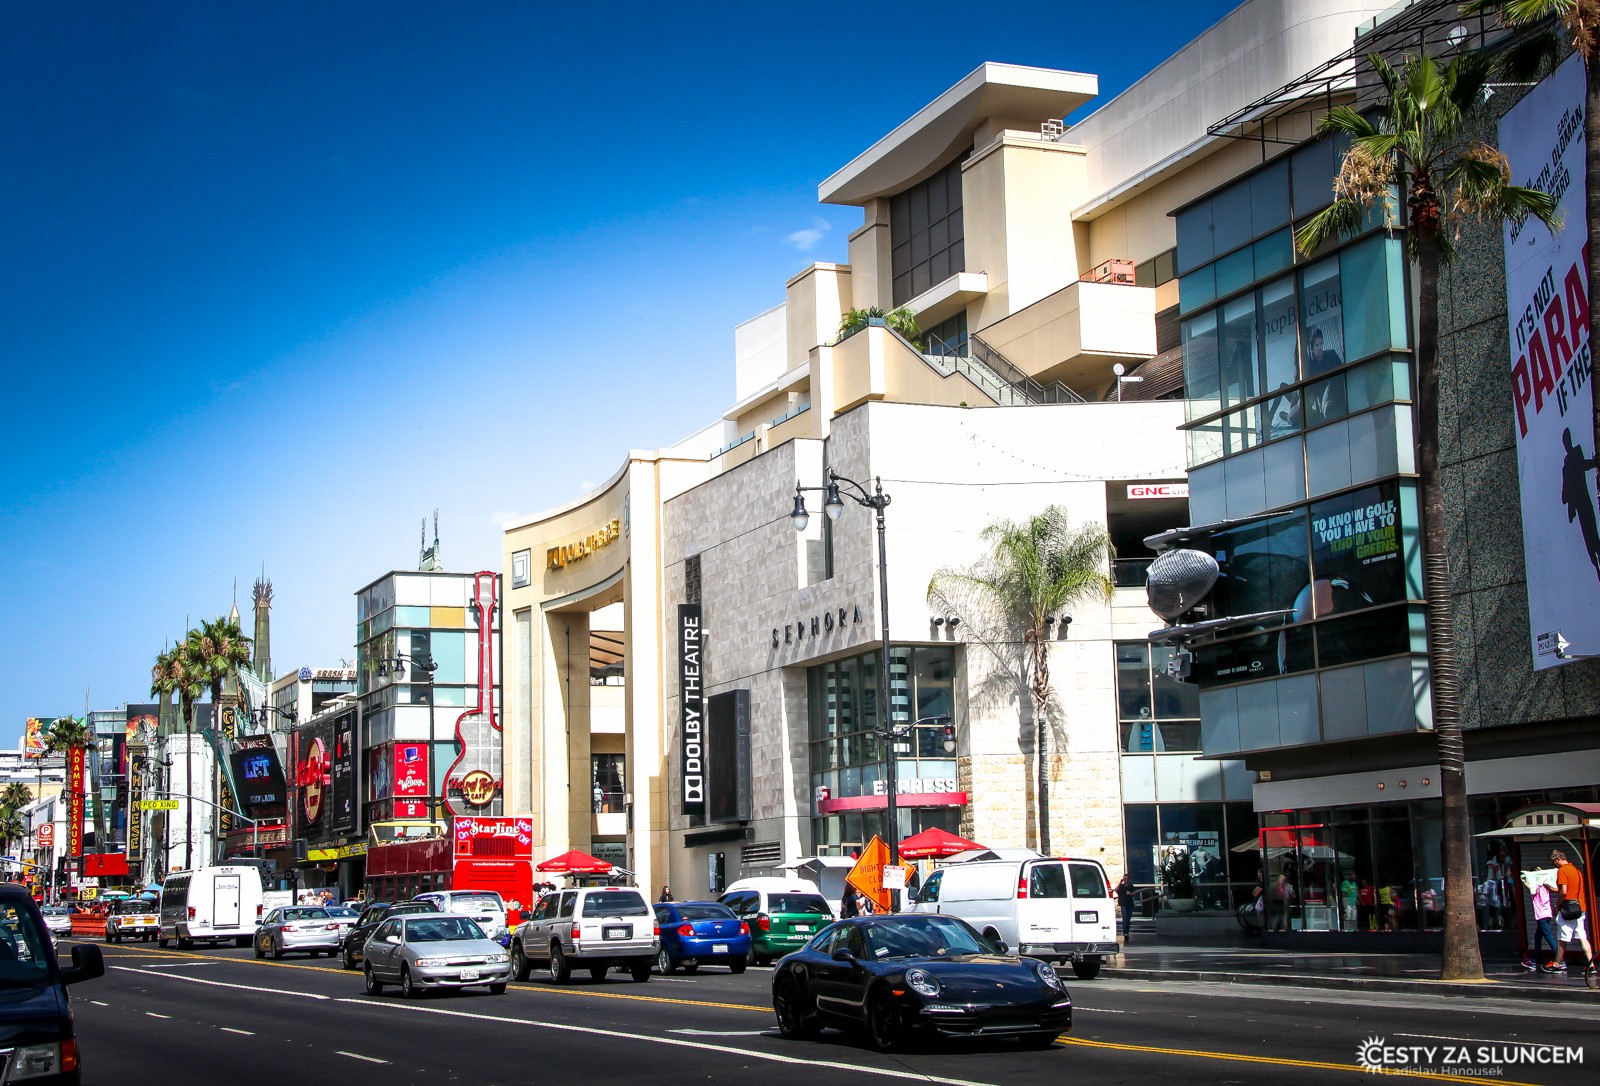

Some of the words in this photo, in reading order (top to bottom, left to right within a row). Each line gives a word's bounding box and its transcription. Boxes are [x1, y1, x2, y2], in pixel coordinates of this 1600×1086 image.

[1533, 265, 1555, 320] NOT
[1131, 487, 1170, 496] GNC
[1313, 518, 1326, 533] TO
[1328, 507, 1364, 528] KNOW
[1366, 499, 1397, 518] GOLF,
[1320, 526, 1341, 543] YOU
[1344, 517, 1375, 537] HAVE
[1379, 512, 1395, 528] TO
[1330, 532, 1365, 553] KNOW
[1367, 525, 1396, 543] YOUR
[1356, 538, 1399, 559] GREENS.
[772, 603, 863, 648] SEPHORA
[684, 616, 700, 703] THEATRE
[686, 707, 701, 772] DOLBY
[73, 743, 81, 788] ADAME
[449, 777, 478, 789] Hard
[407, 804, 416, 815] 2
[860, 863, 881, 875] RIGHT
